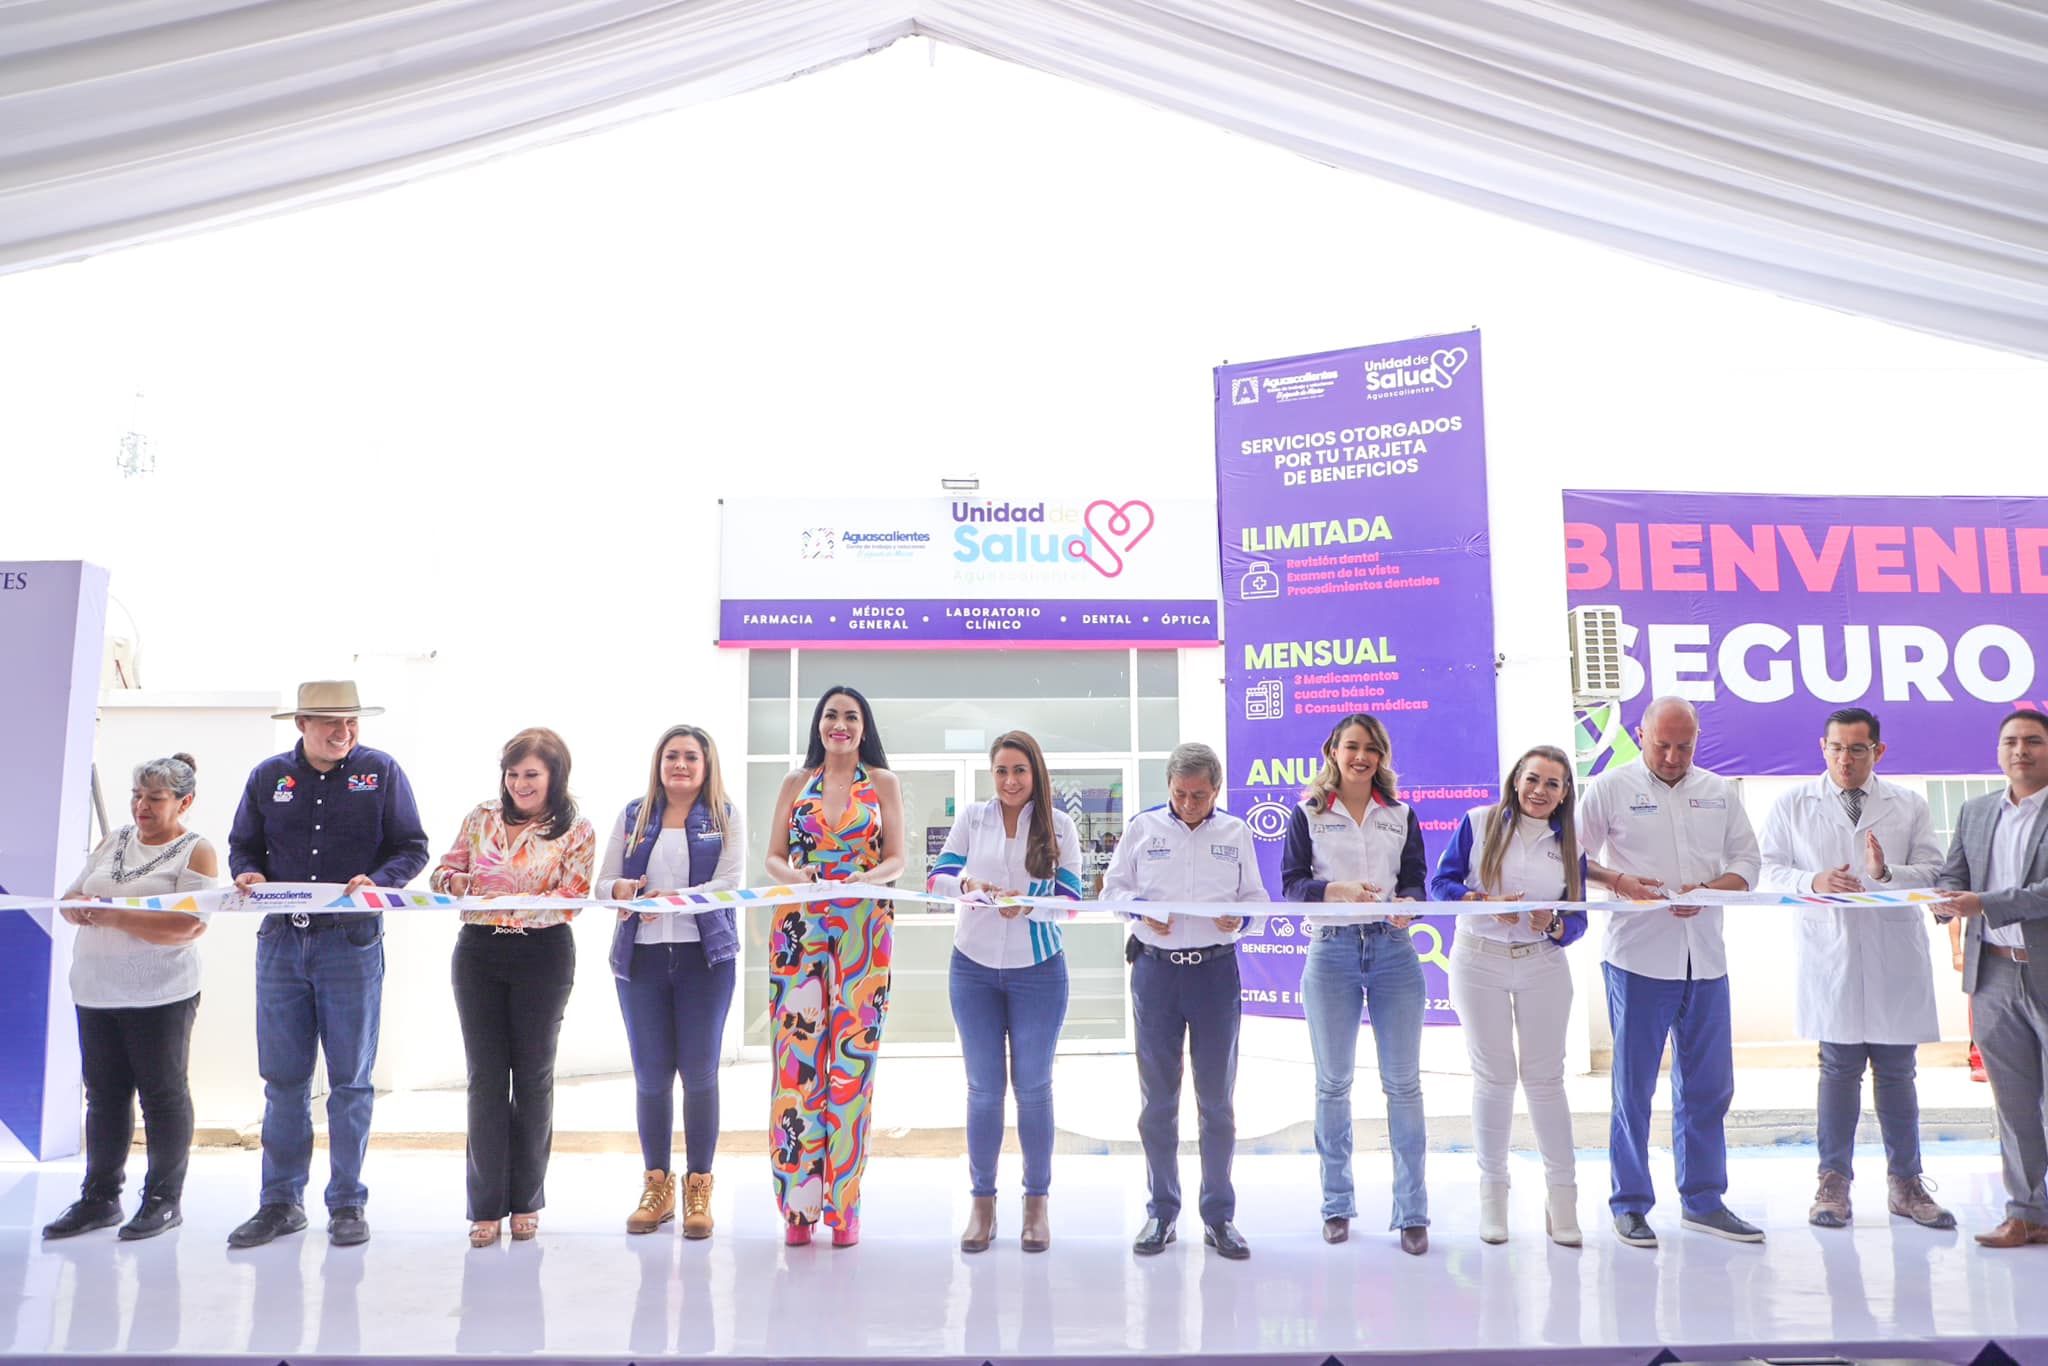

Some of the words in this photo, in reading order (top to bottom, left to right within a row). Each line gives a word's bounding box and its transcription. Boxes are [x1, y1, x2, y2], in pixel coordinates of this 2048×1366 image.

[1364, 355, 1412, 372] Unidad
[1412, 355, 1429, 366] de
[1366, 364, 1437, 391] Salud
[1366, 386, 1435, 401] Aguascalientes
[1241, 431, 1336, 455] SERVICIOS
[1339, 415, 1463, 444] OTORGADOS
[1274, 452, 1311, 470] POR
[1315, 448, 1340, 465] TU
[1342, 438, 1427, 462] TARJETA
[1283, 470, 1307, 487] DE
[1310, 457, 1419, 484] BENEFICIOS
[952, 502, 1045, 522] Unidad
[1049, 504, 1079, 522] de
[841, 531, 930, 544] Aguascalientes
[1242, 515, 1393, 552] ILIMITADA
[953, 524, 1093, 563] Salud
[1286, 557, 1338, 570] Revisión
[1339, 552, 1379, 565] dental
[1286, 571, 1335, 583] Examen
[1337, 569, 1351, 579] de
[1354, 566, 1366, 577] la
[1368, 564, 1400, 576] vista
[1287, 580, 1382, 597] Procedimientos
[1384, 576, 1440, 590] dentales
[743, 614, 813, 625] FARMACIA
[852, 605, 905, 617] MÉDICO
[946, 607, 1041, 618] LABORATORIO
[1082, 614, 1132, 624] DENTAL
[1161, 612, 1211, 625] ÓPTICA
[848, 619, 909, 630] GENERAL
[965, 618, 1021, 630] CLÍNICO
[1244, 636, 1397, 670] MENSUAL
[1621, 622, 2035, 703] SEGURO
[1303, 671, 1399, 685] Medicamentos
[1294, 689, 1340, 700] cuadro
[1341, 686, 1385, 698] básico
[1304, 702, 1369, 714] Consultas
[1371, 699, 1429, 711] médicas
[1246, 757, 1317, 787] ANU
[1412, 787, 1489, 802] graduados
[1419, 818, 1460, 831] ratori
[249, 891, 313, 901] Aguascalientes
[1241, 943, 1295, 955] BENEFICIO
[1240, 989, 1278, 1004] CITAS
[1281, 991, 1291, 1004] E
